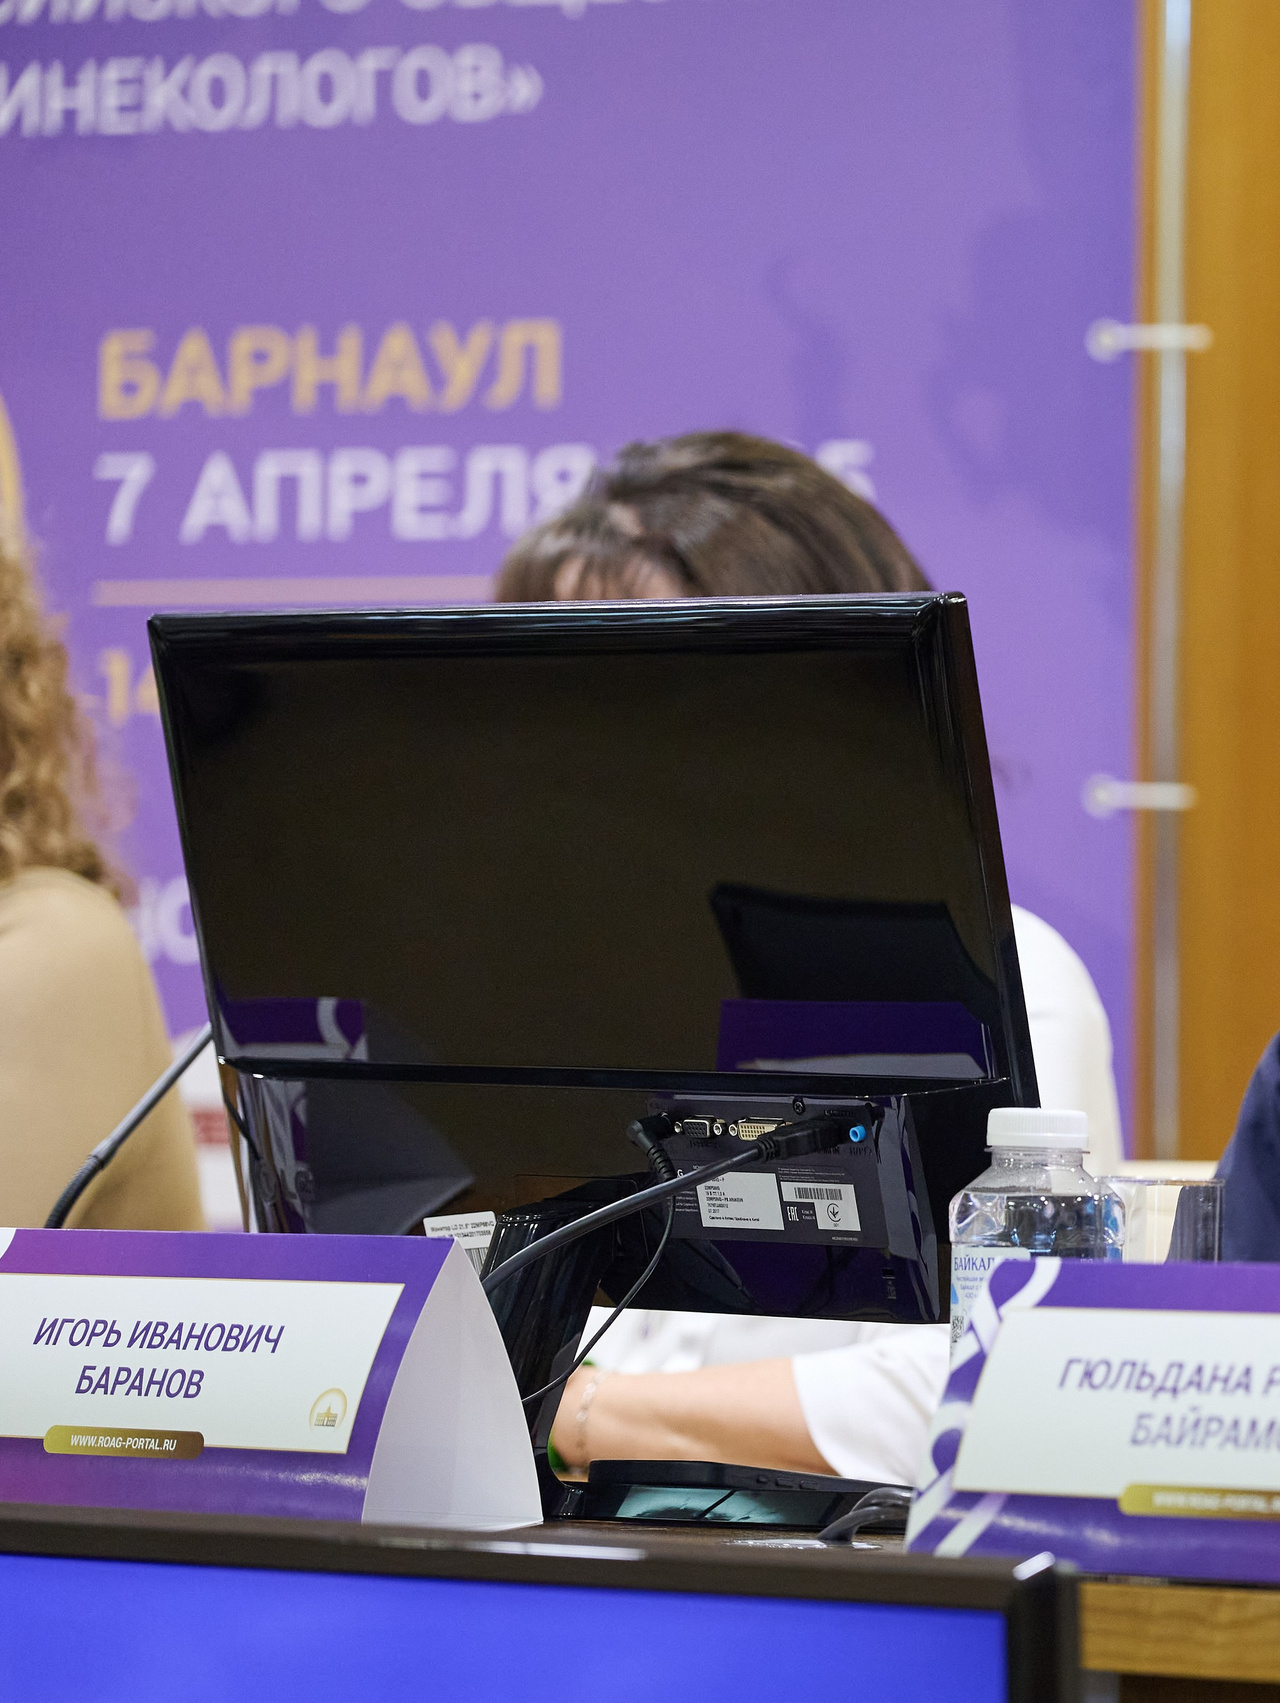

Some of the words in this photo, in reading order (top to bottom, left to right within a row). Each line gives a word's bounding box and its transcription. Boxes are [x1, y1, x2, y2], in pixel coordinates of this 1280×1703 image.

[97, 317, 563, 421] БАРНАУЛ
[94, 450, 156, 546] 7
[178, 443, 598, 546] АПРЕЛЯ
[33, 1317, 122, 1348] ИГОРЬ
[127, 1320, 286, 1354] ИВАНОВИЧ
[74, 1365, 205, 1399] БАРАНОВ
[1058, 1357, 1252, 1398] ГЮЛЬДАНА
[70, 1434, 177, 1451] WWW.ROAG-PORTAL.RU
